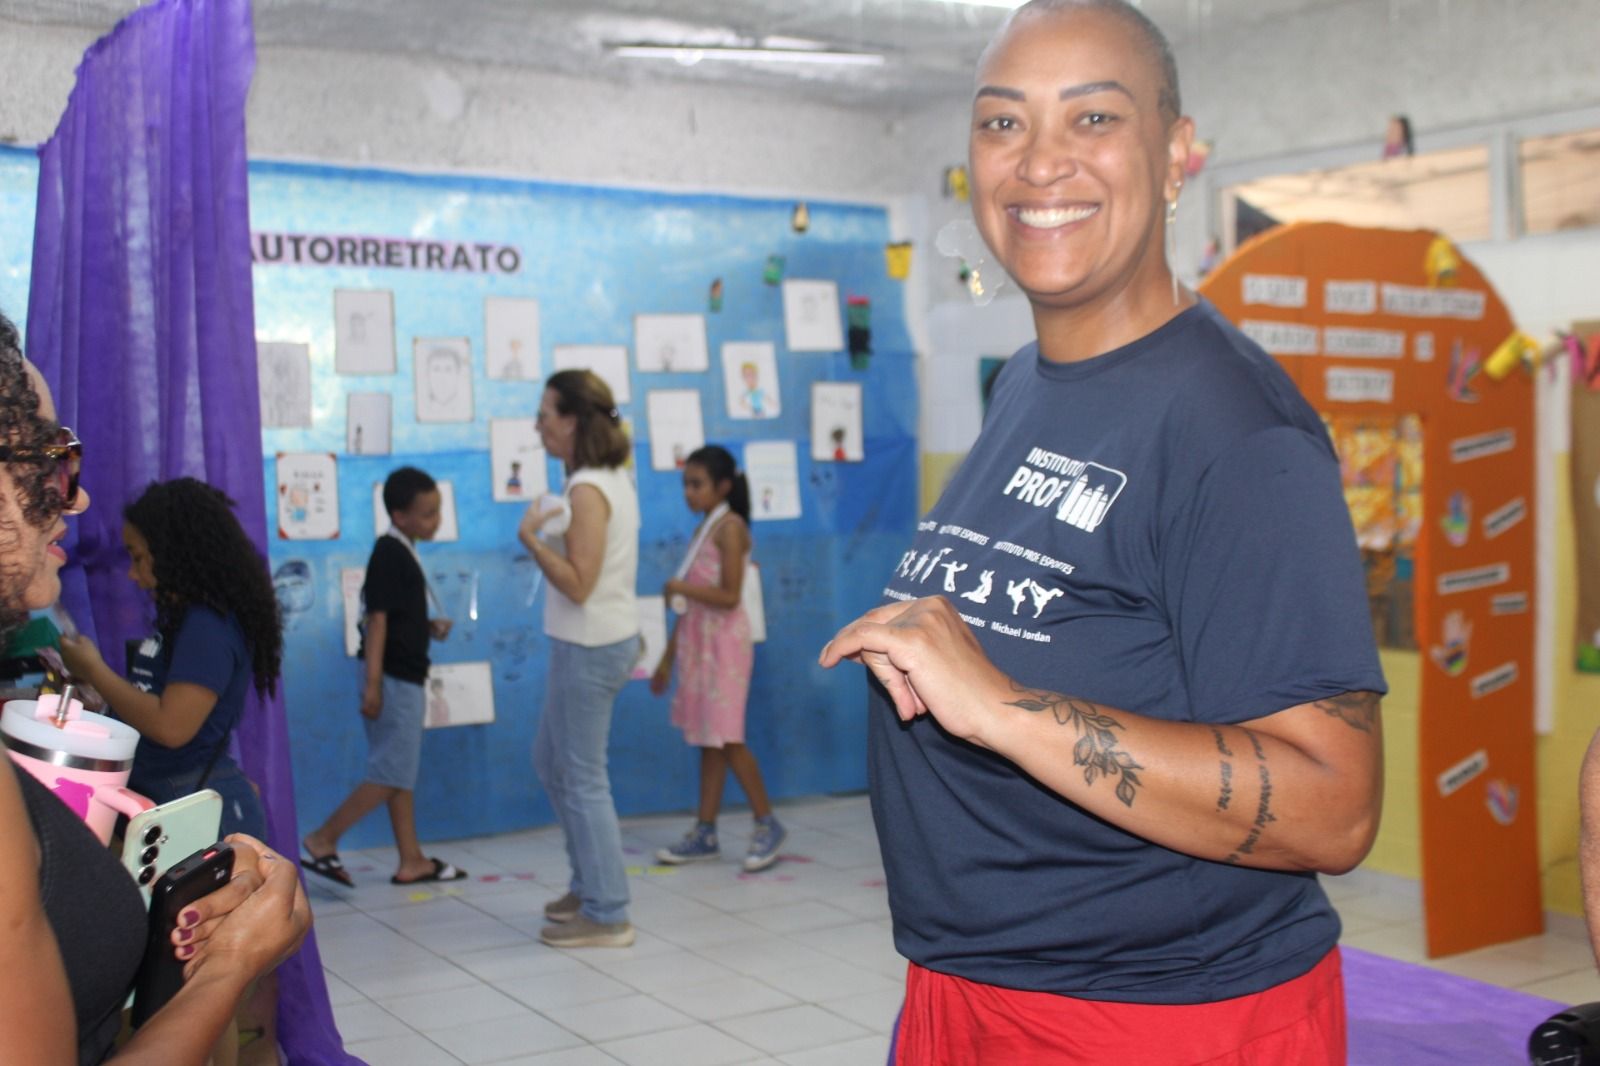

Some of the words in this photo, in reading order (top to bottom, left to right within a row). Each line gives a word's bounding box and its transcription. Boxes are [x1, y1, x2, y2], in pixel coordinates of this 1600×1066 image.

[1025, 446, 1086, 477] INSTITUTO
[1003, 465, 1071, 508] PROF
[1039, 555, 1076, 575] ESPORTES
[991, 621, 1021, 637] Michael
[1021, 629, 1052, 643] Jordan
